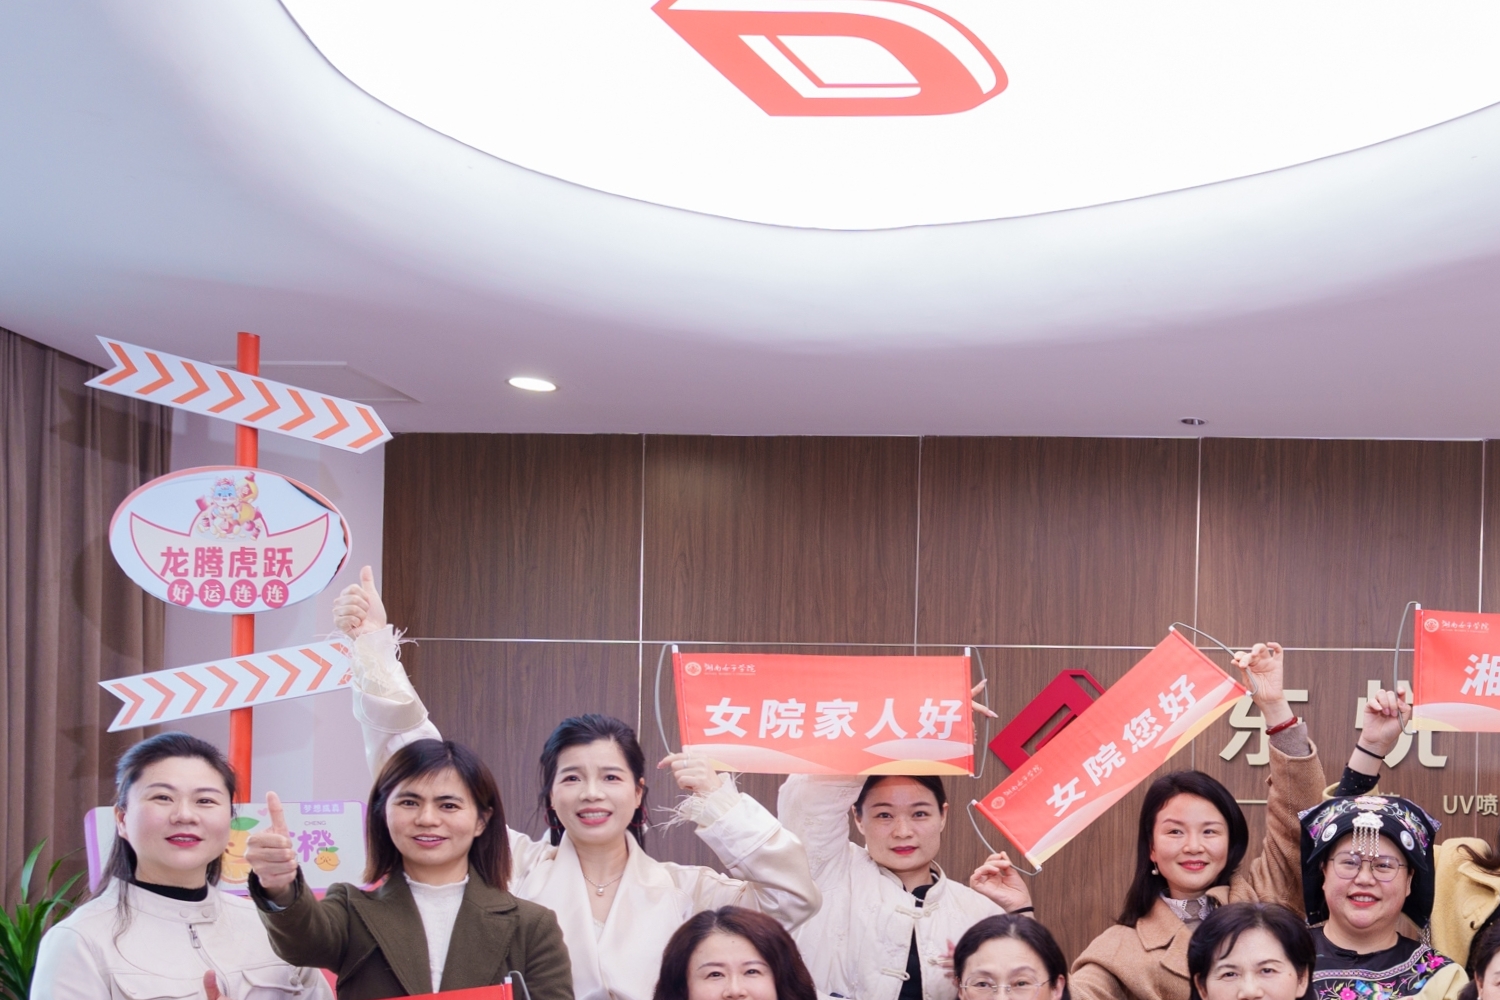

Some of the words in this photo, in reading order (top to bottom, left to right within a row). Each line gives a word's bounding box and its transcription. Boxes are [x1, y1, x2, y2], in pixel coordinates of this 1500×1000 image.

[159, 546, 294, 579] 龙腾虎跃
[171, 583, 285, 604] 好运连连
[703, 697, 963, 740] 女院家人好
[1045, 674, 1198, 818] 女院您好
[288, 829, 335, 863] 橙
